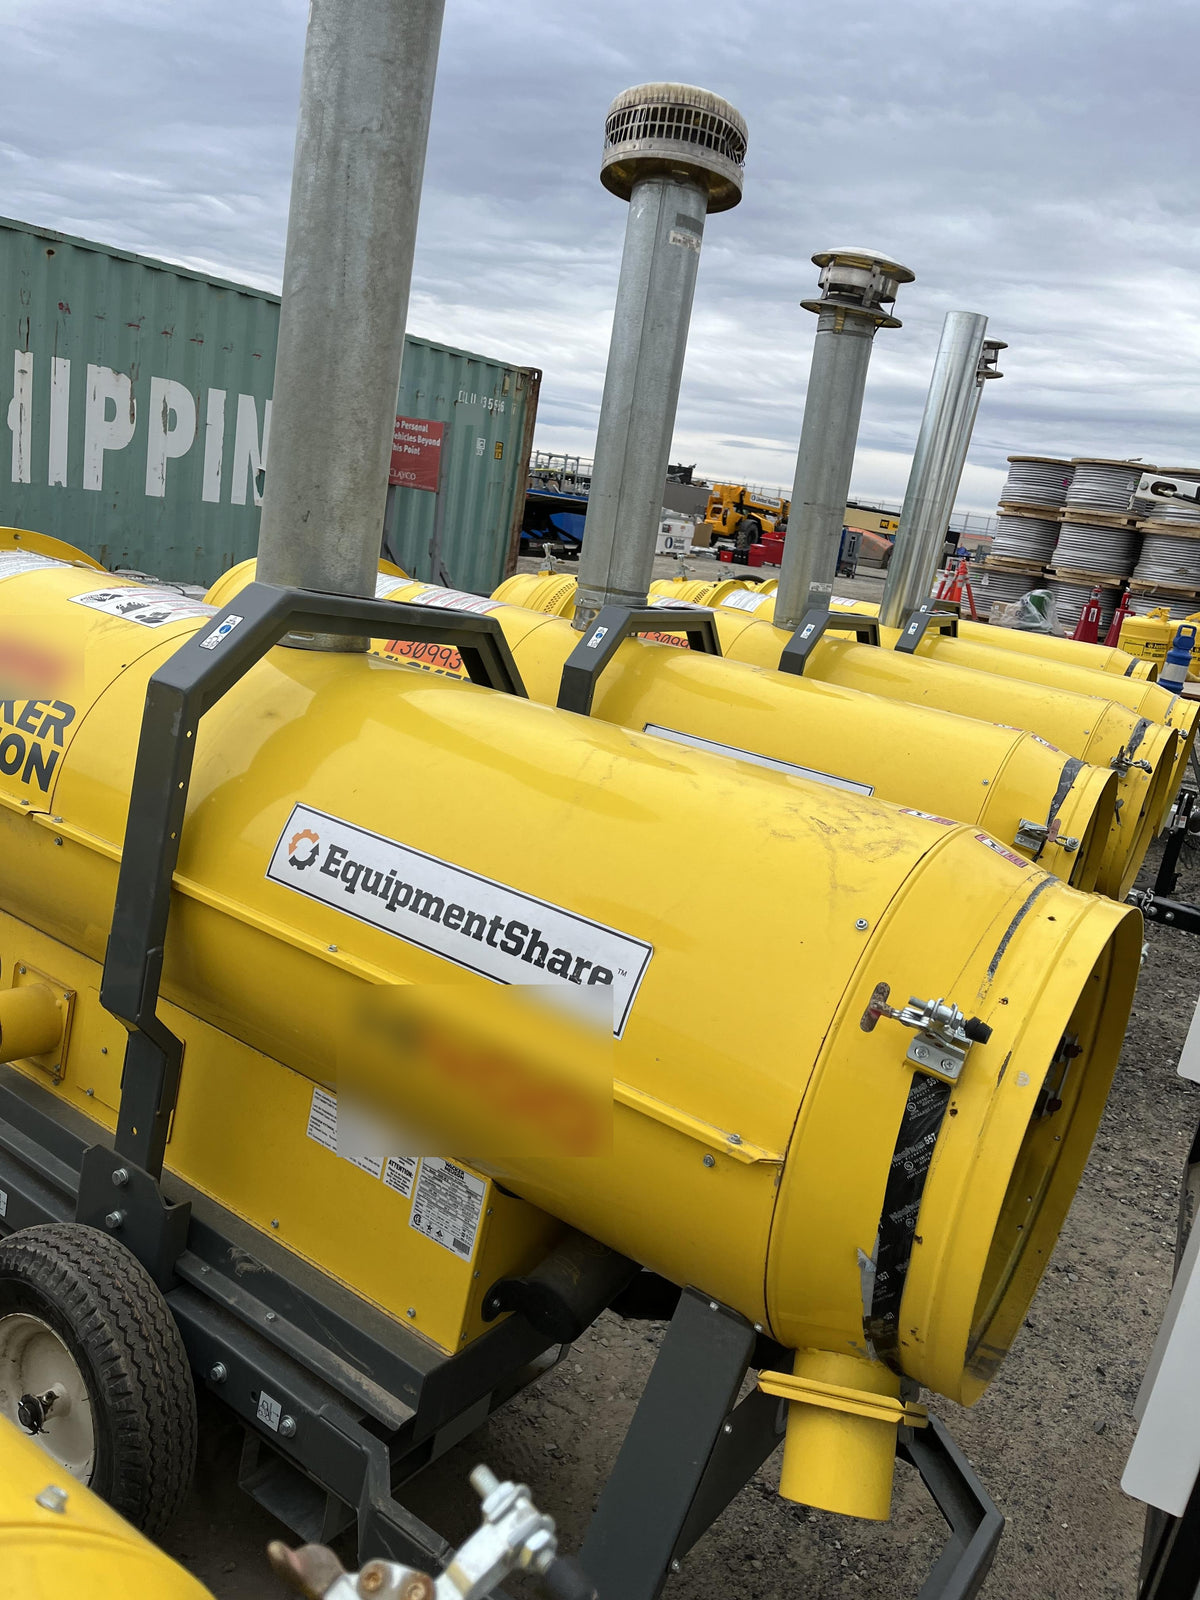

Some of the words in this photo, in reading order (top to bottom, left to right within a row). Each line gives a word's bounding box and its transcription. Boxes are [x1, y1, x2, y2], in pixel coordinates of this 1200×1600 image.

[401, 420, 429, 433] Personal
[393, 431, 417, 443] ehicles
[417, 435, 441, 447] Beyond
[403, 444, 421, 456] Point
[319, 843, 614, 986] EquipmentShare
